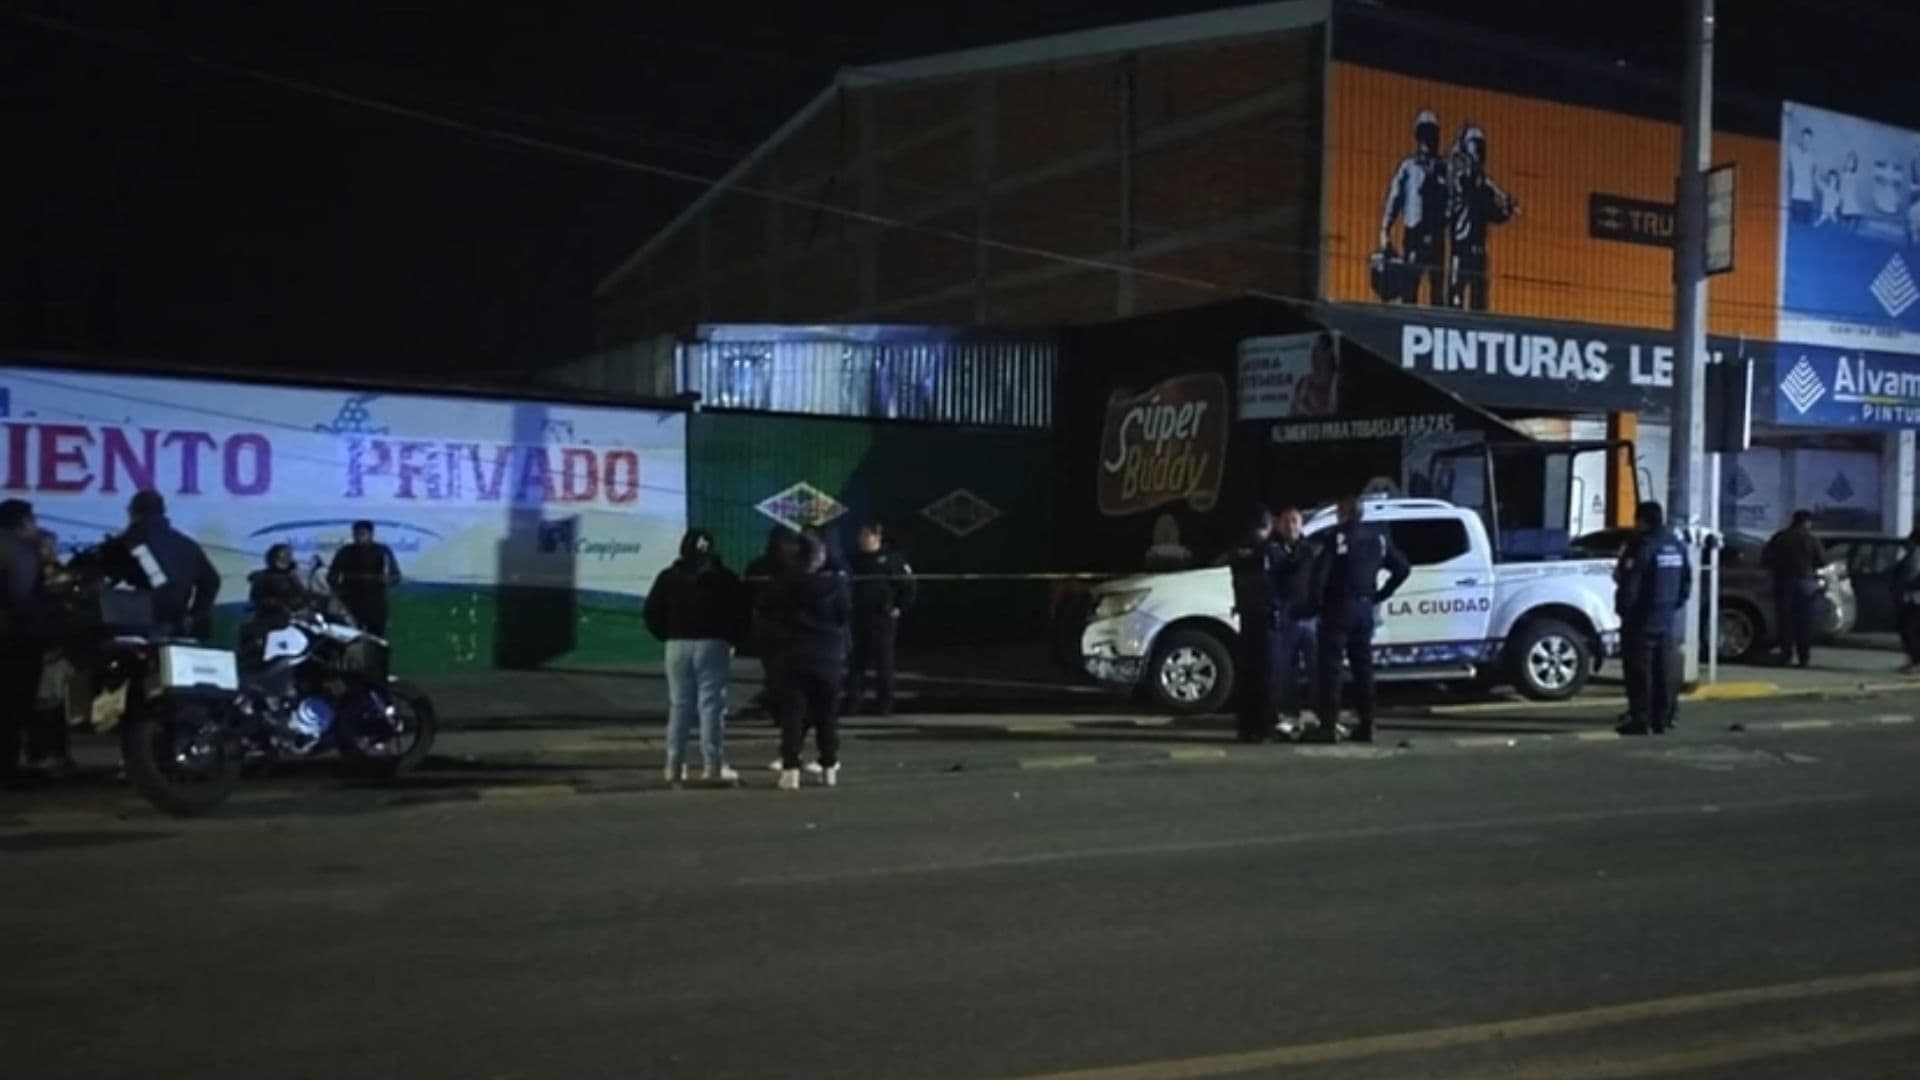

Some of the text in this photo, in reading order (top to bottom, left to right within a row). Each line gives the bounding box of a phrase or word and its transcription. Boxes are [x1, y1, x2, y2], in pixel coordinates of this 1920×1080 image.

[1627, 210, 1674, 236] TRU
[1401, 325, 1609, 382] PINTURAS
[1409, 413, 1455, 435] RAZAS
[2, 423, 639, 504] IENTO PRIVADO
[1120, 442, 1211, 501] Buddy
[1387, 597, 1491, 616] LA CIUDAD
